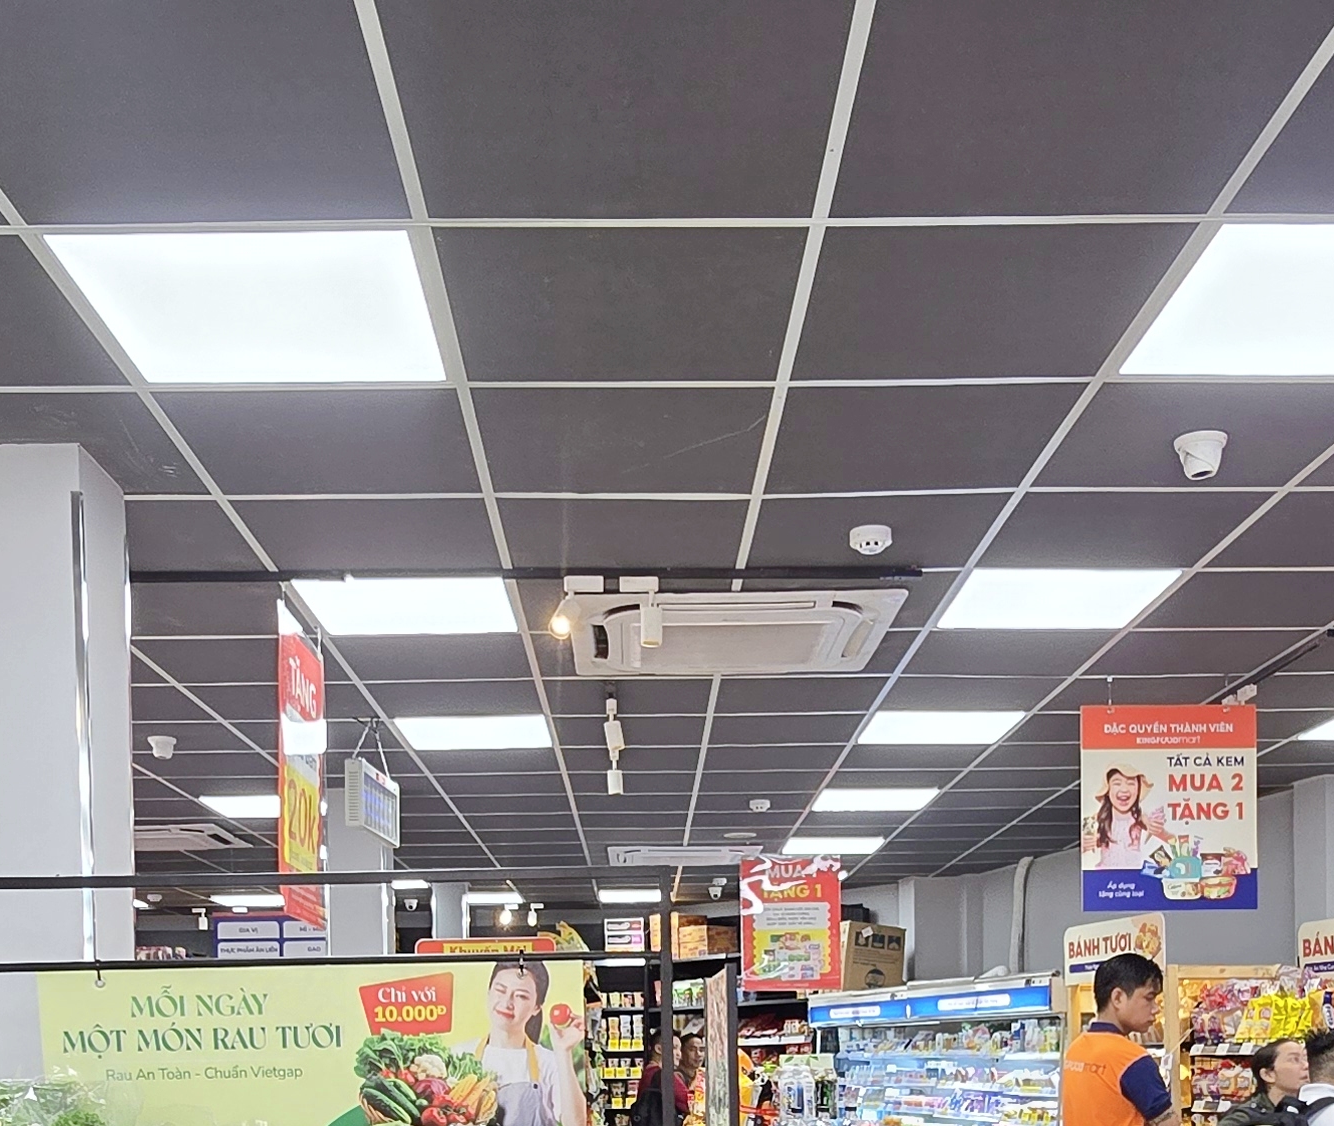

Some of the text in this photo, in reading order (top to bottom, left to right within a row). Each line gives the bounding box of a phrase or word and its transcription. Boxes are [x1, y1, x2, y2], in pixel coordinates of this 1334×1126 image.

[1169, 721, 1207, 733] THÀNH
[1208, 721, 1234, 733] VIÊN
[1167, 752, 1245, 767] TẤT CẢ KEM
[1168, 773, 1244, 792] MUA 2
[1167, 798, 1244, 826] TẶNG 1
[814, 884, 822, 898] 1
[1068, 930, 1132, 960] BÁNH TƯƠI
[130, 984, 269, 1018] MỖI NGÀY
[377, 985, 437, 1004] Chỉ với
[63, 1023, 343, 1057] MỘT MÓN RAU TƯƠI
[105, 1063, 303, 1082] Rau An Toàn Chuẩn Vietgap
